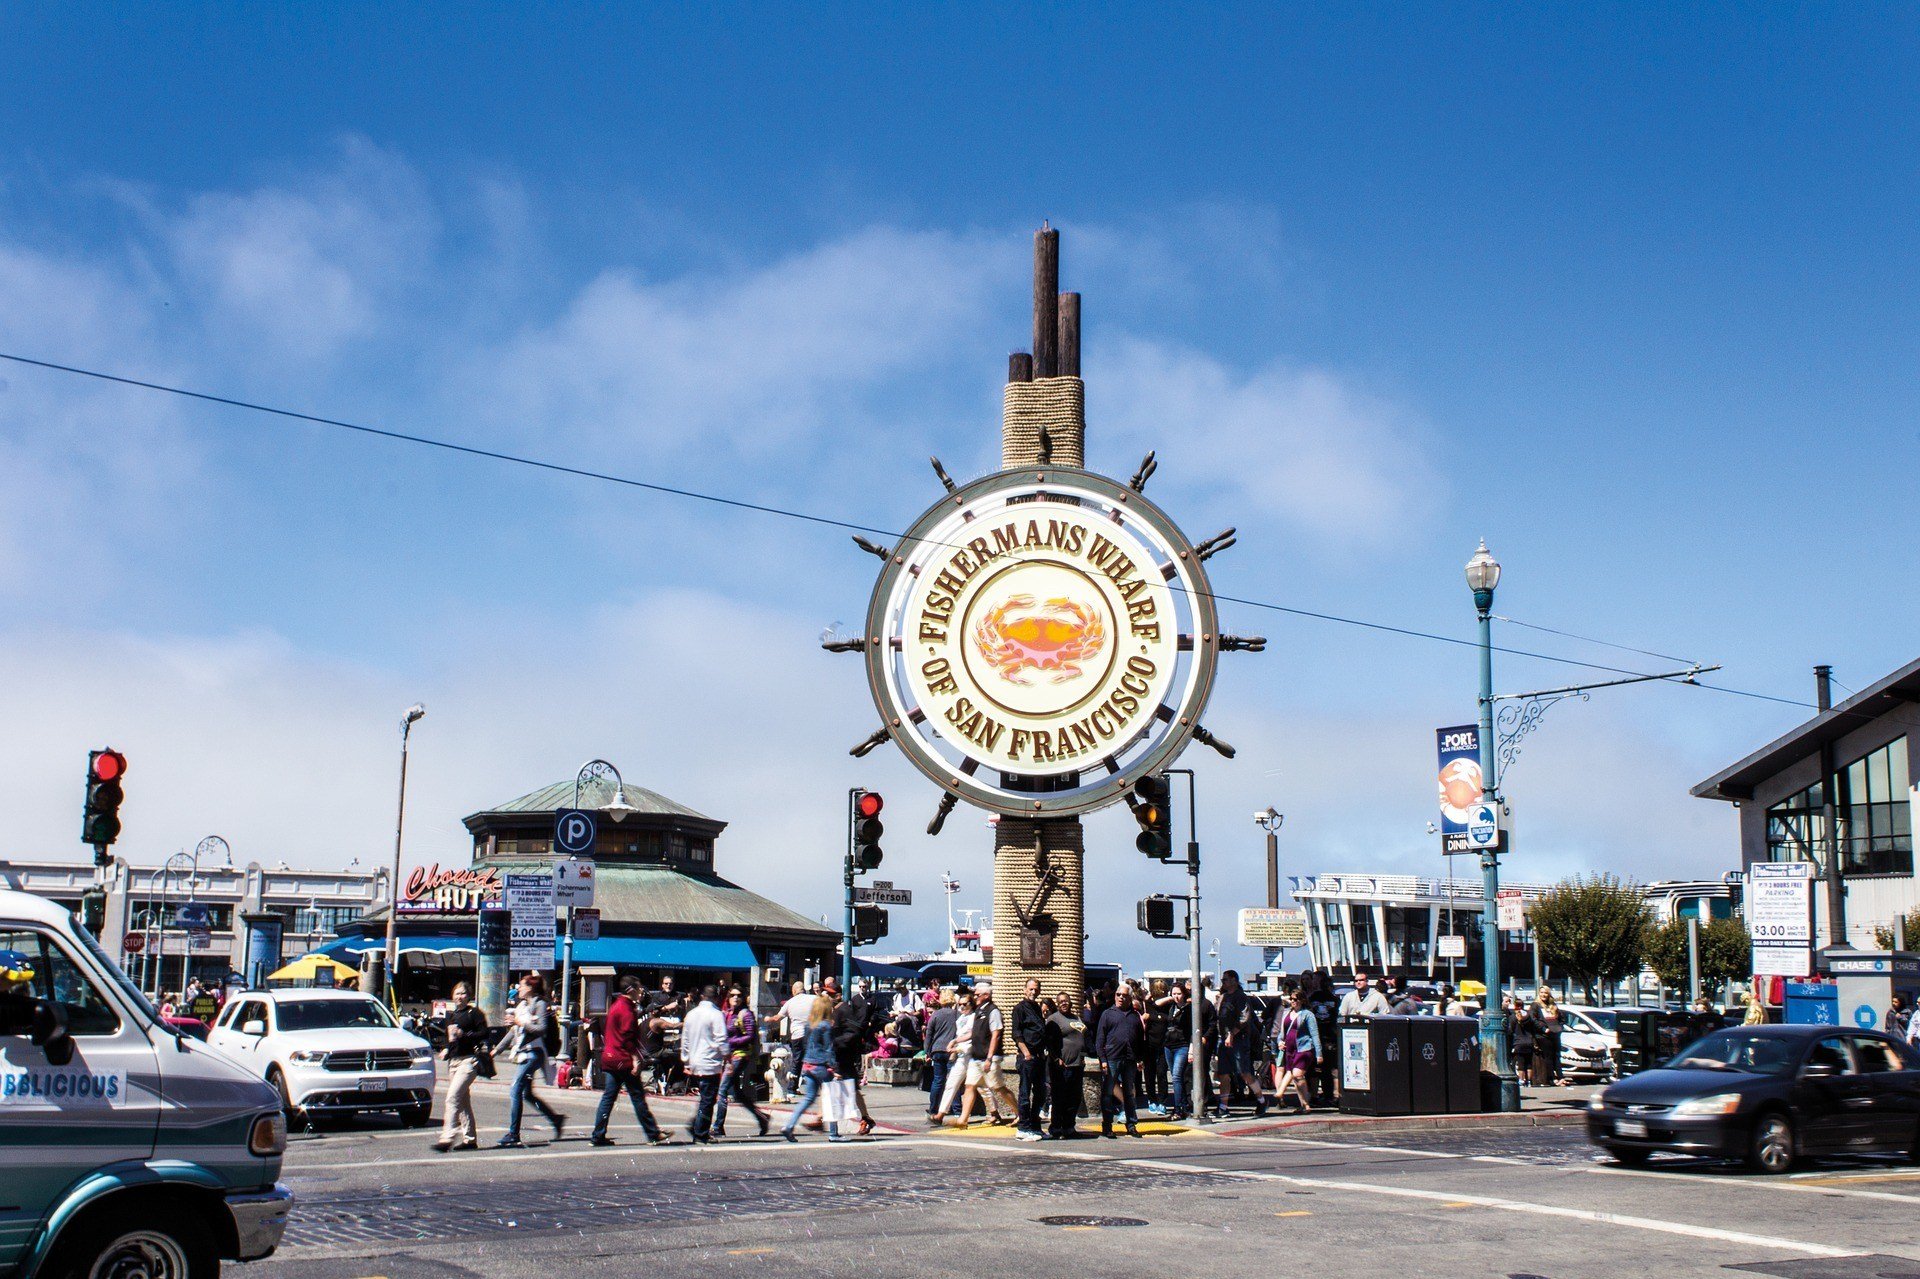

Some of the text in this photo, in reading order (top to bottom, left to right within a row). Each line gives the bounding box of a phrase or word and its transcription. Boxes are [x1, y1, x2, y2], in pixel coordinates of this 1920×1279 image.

[919, 519, 1161, 644] FISHERMANS WHARF
[922, 656, 1157, 762] OF SAN FRANCISCO
[1445, 732, 1472, 747] PORT
[1447, 839, 1471, 851] DININ
[403, 863, 503, 900] Chowde
[557, 883, 592, 891] Fisherman's
[434, 888, 484, 909] HUT
[859, 892, 908, 902] Jefferson
[511, 928, 536, 938] 3.00
[1754, 925, 1785, 936] $3.00
[125, 938, 144, 947] STOP
[1837, 961, 1874, 970] CHASE
[1895, 962, 1918, 970] CHASE
[195, 998, 214, 1006] PUBLIC
[193, 1006, 216, 1014] PARKING
[0, 1073, 119, 1098] BBLICIOUS
